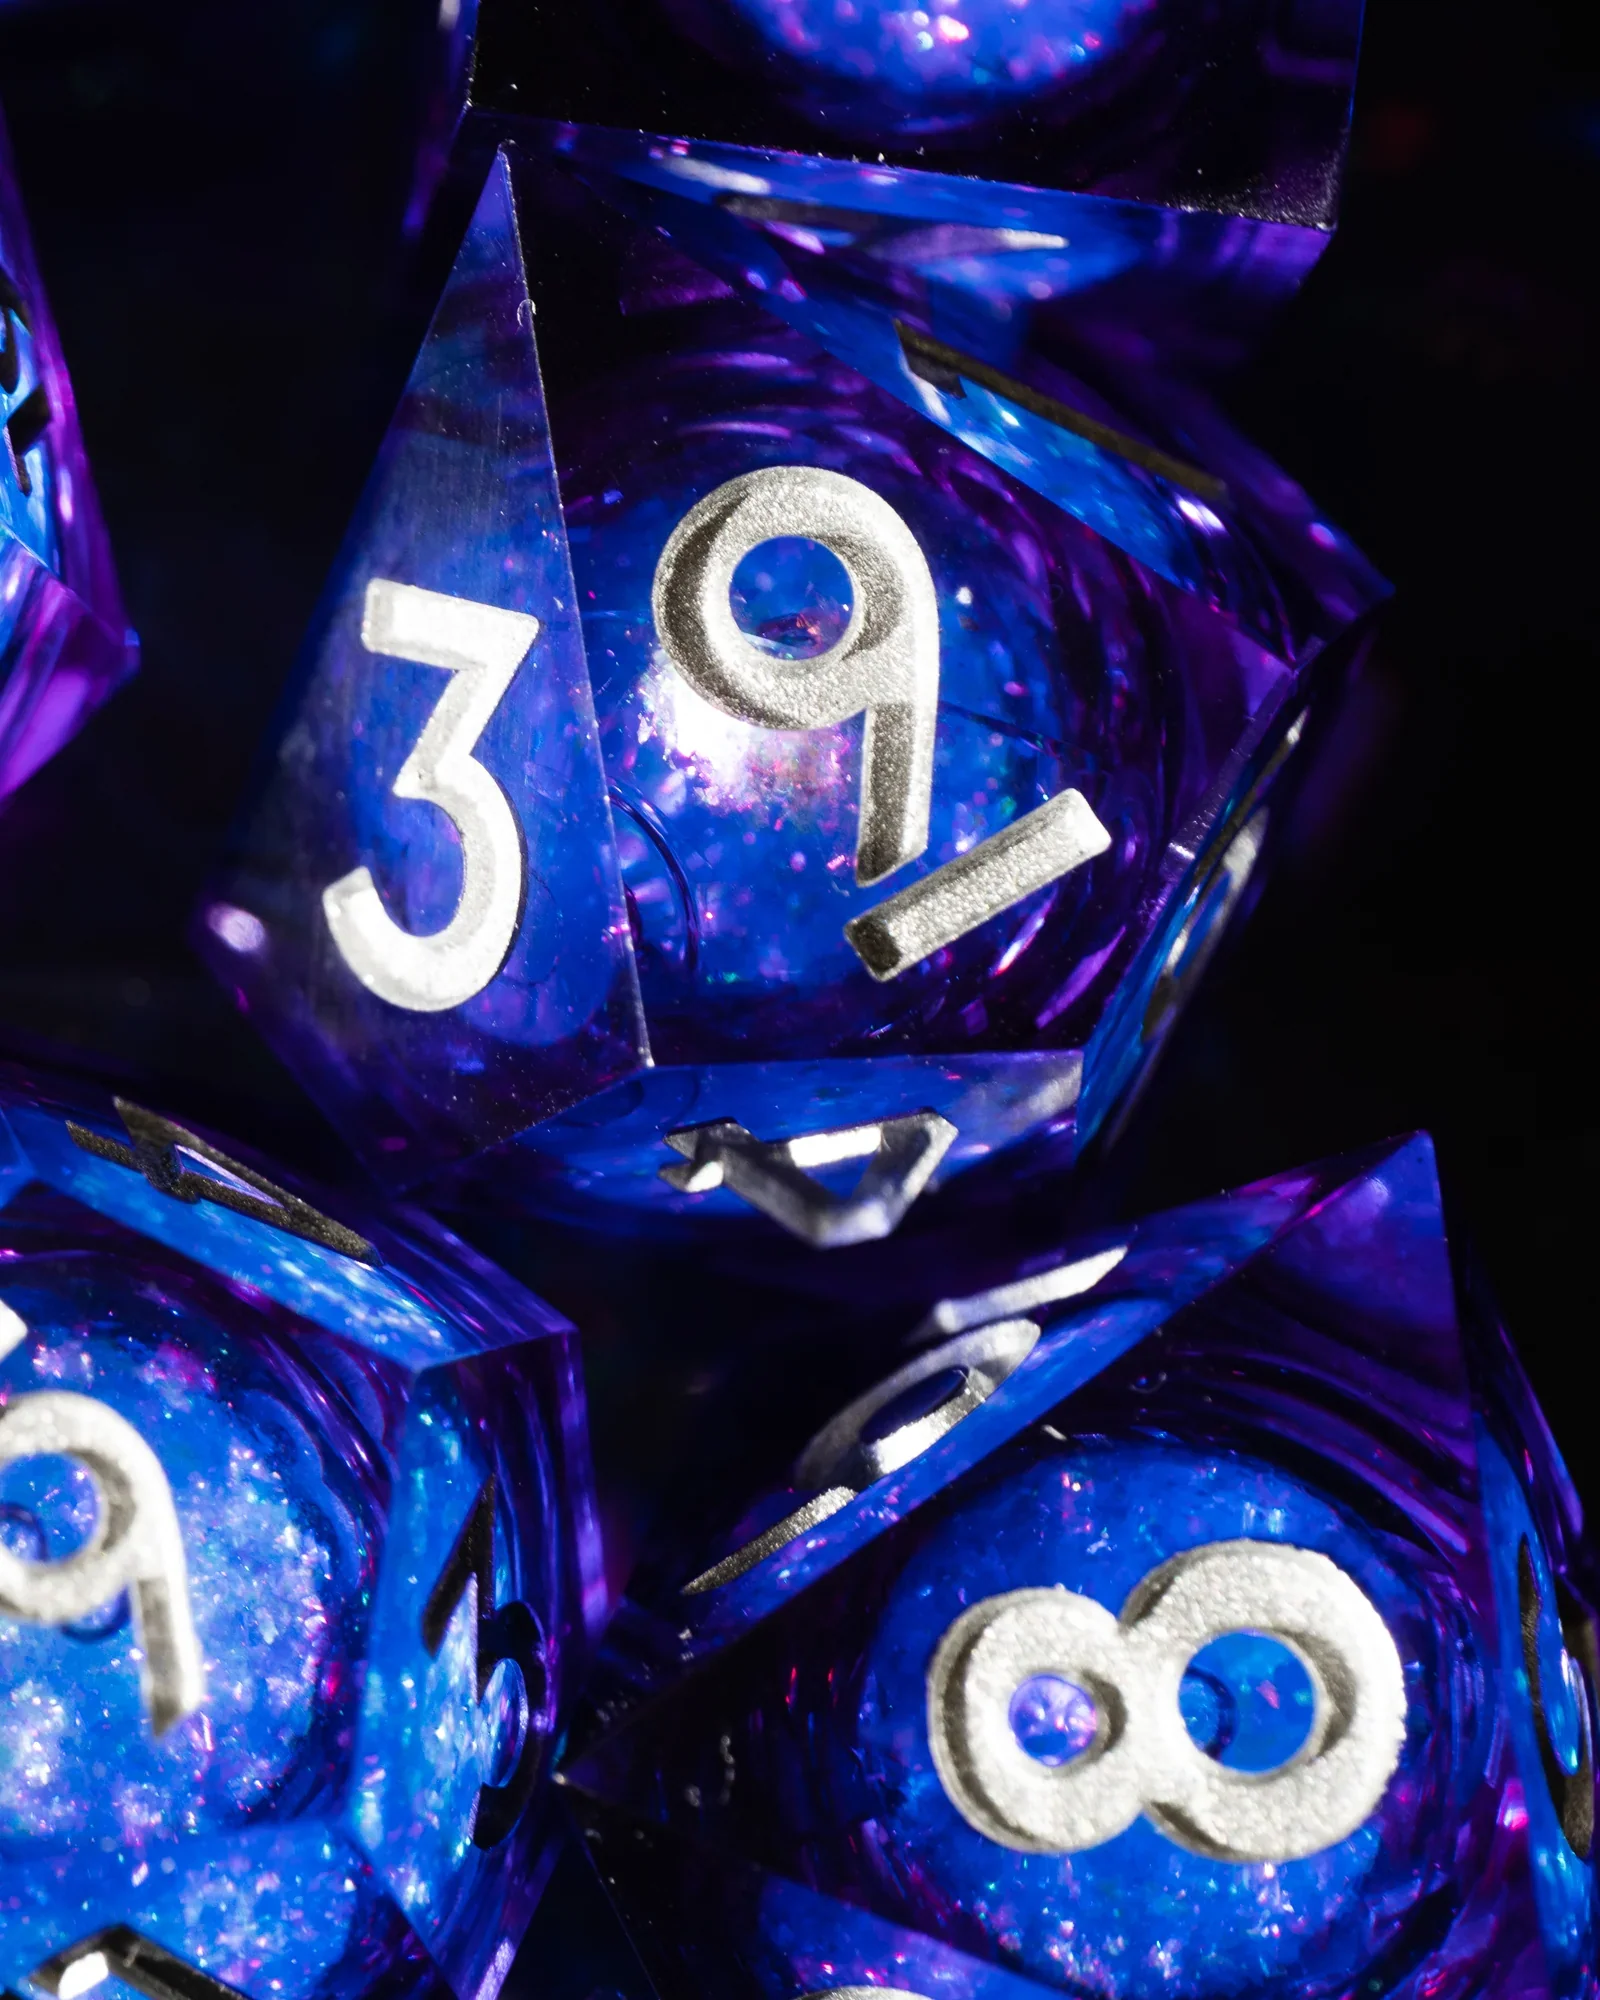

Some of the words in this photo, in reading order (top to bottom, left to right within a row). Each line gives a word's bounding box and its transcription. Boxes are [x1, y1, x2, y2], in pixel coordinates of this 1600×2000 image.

[322, 577, 541, 1012] 3
[651, 464, 941, 888] 9
[926, 1538, 1406, 1863] 8
